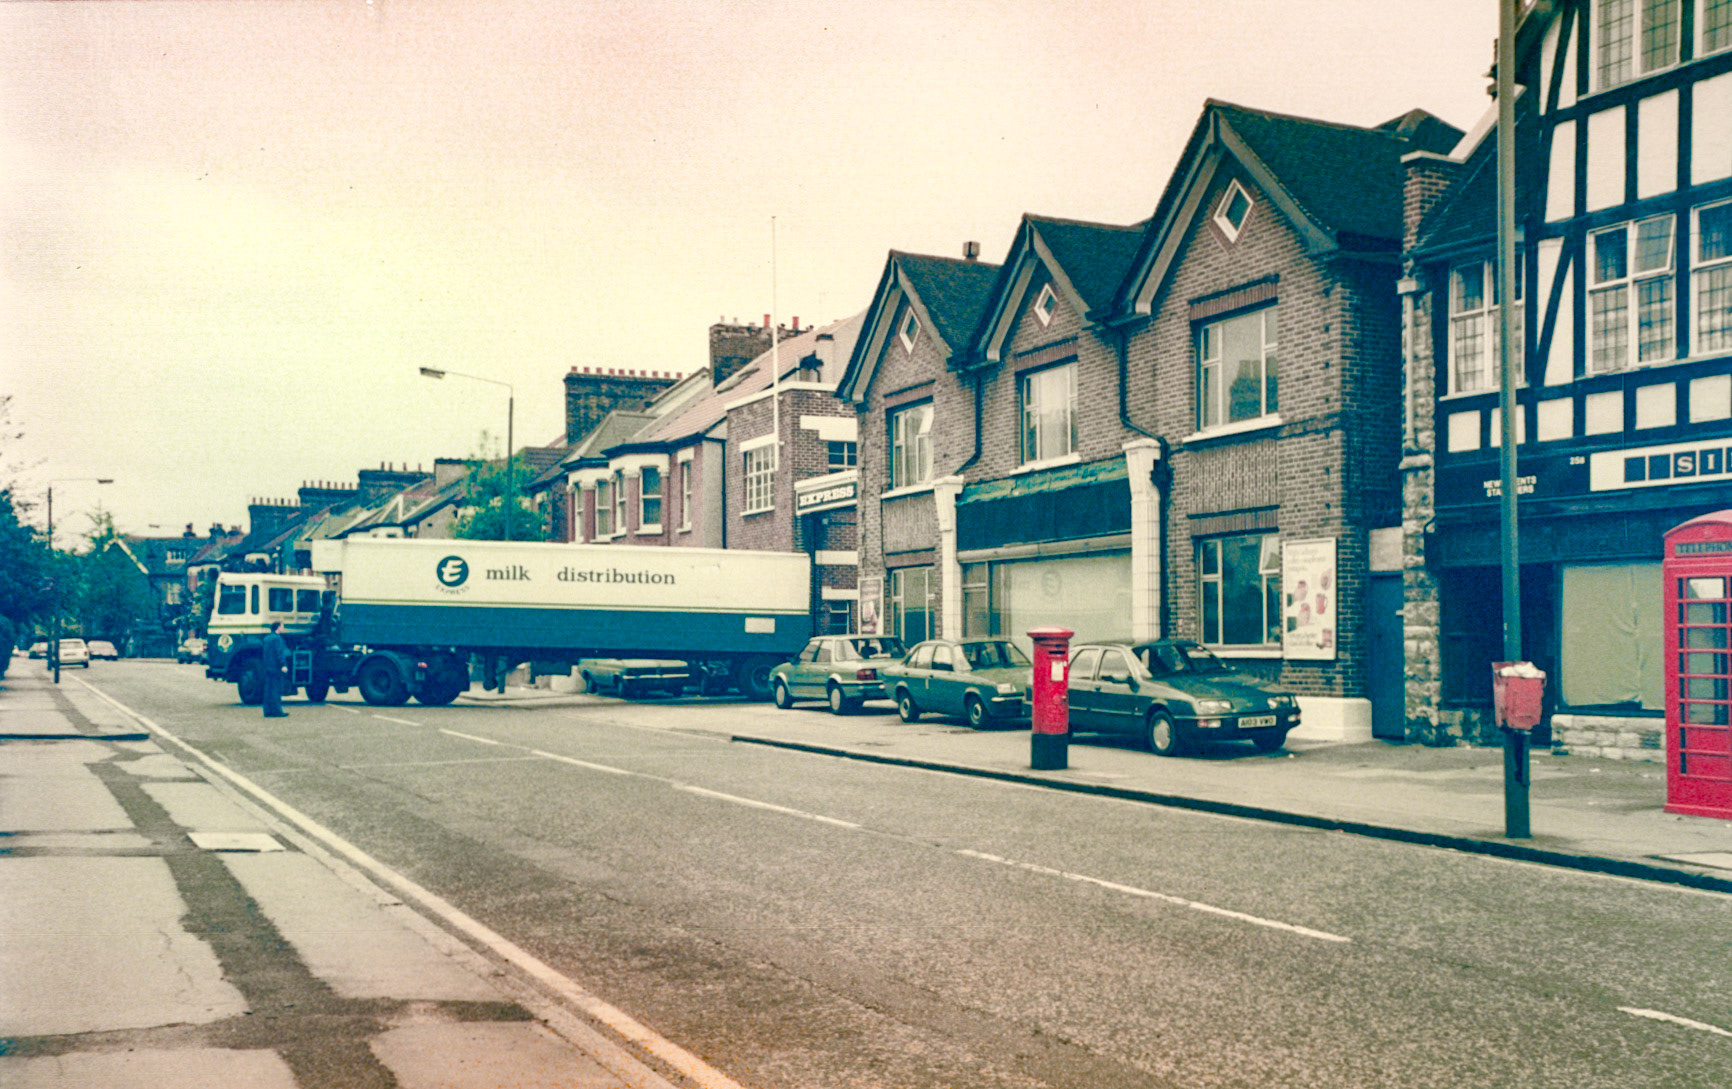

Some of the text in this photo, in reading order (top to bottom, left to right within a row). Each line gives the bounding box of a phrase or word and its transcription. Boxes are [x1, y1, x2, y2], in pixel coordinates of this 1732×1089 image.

[1677, 452, 1732, 473] SI
[1483, 475, 1537, 489] NEWENTS
[799, 485, 855, 506] EXPRESS
[486, 565, 676, 585] milk distribution
